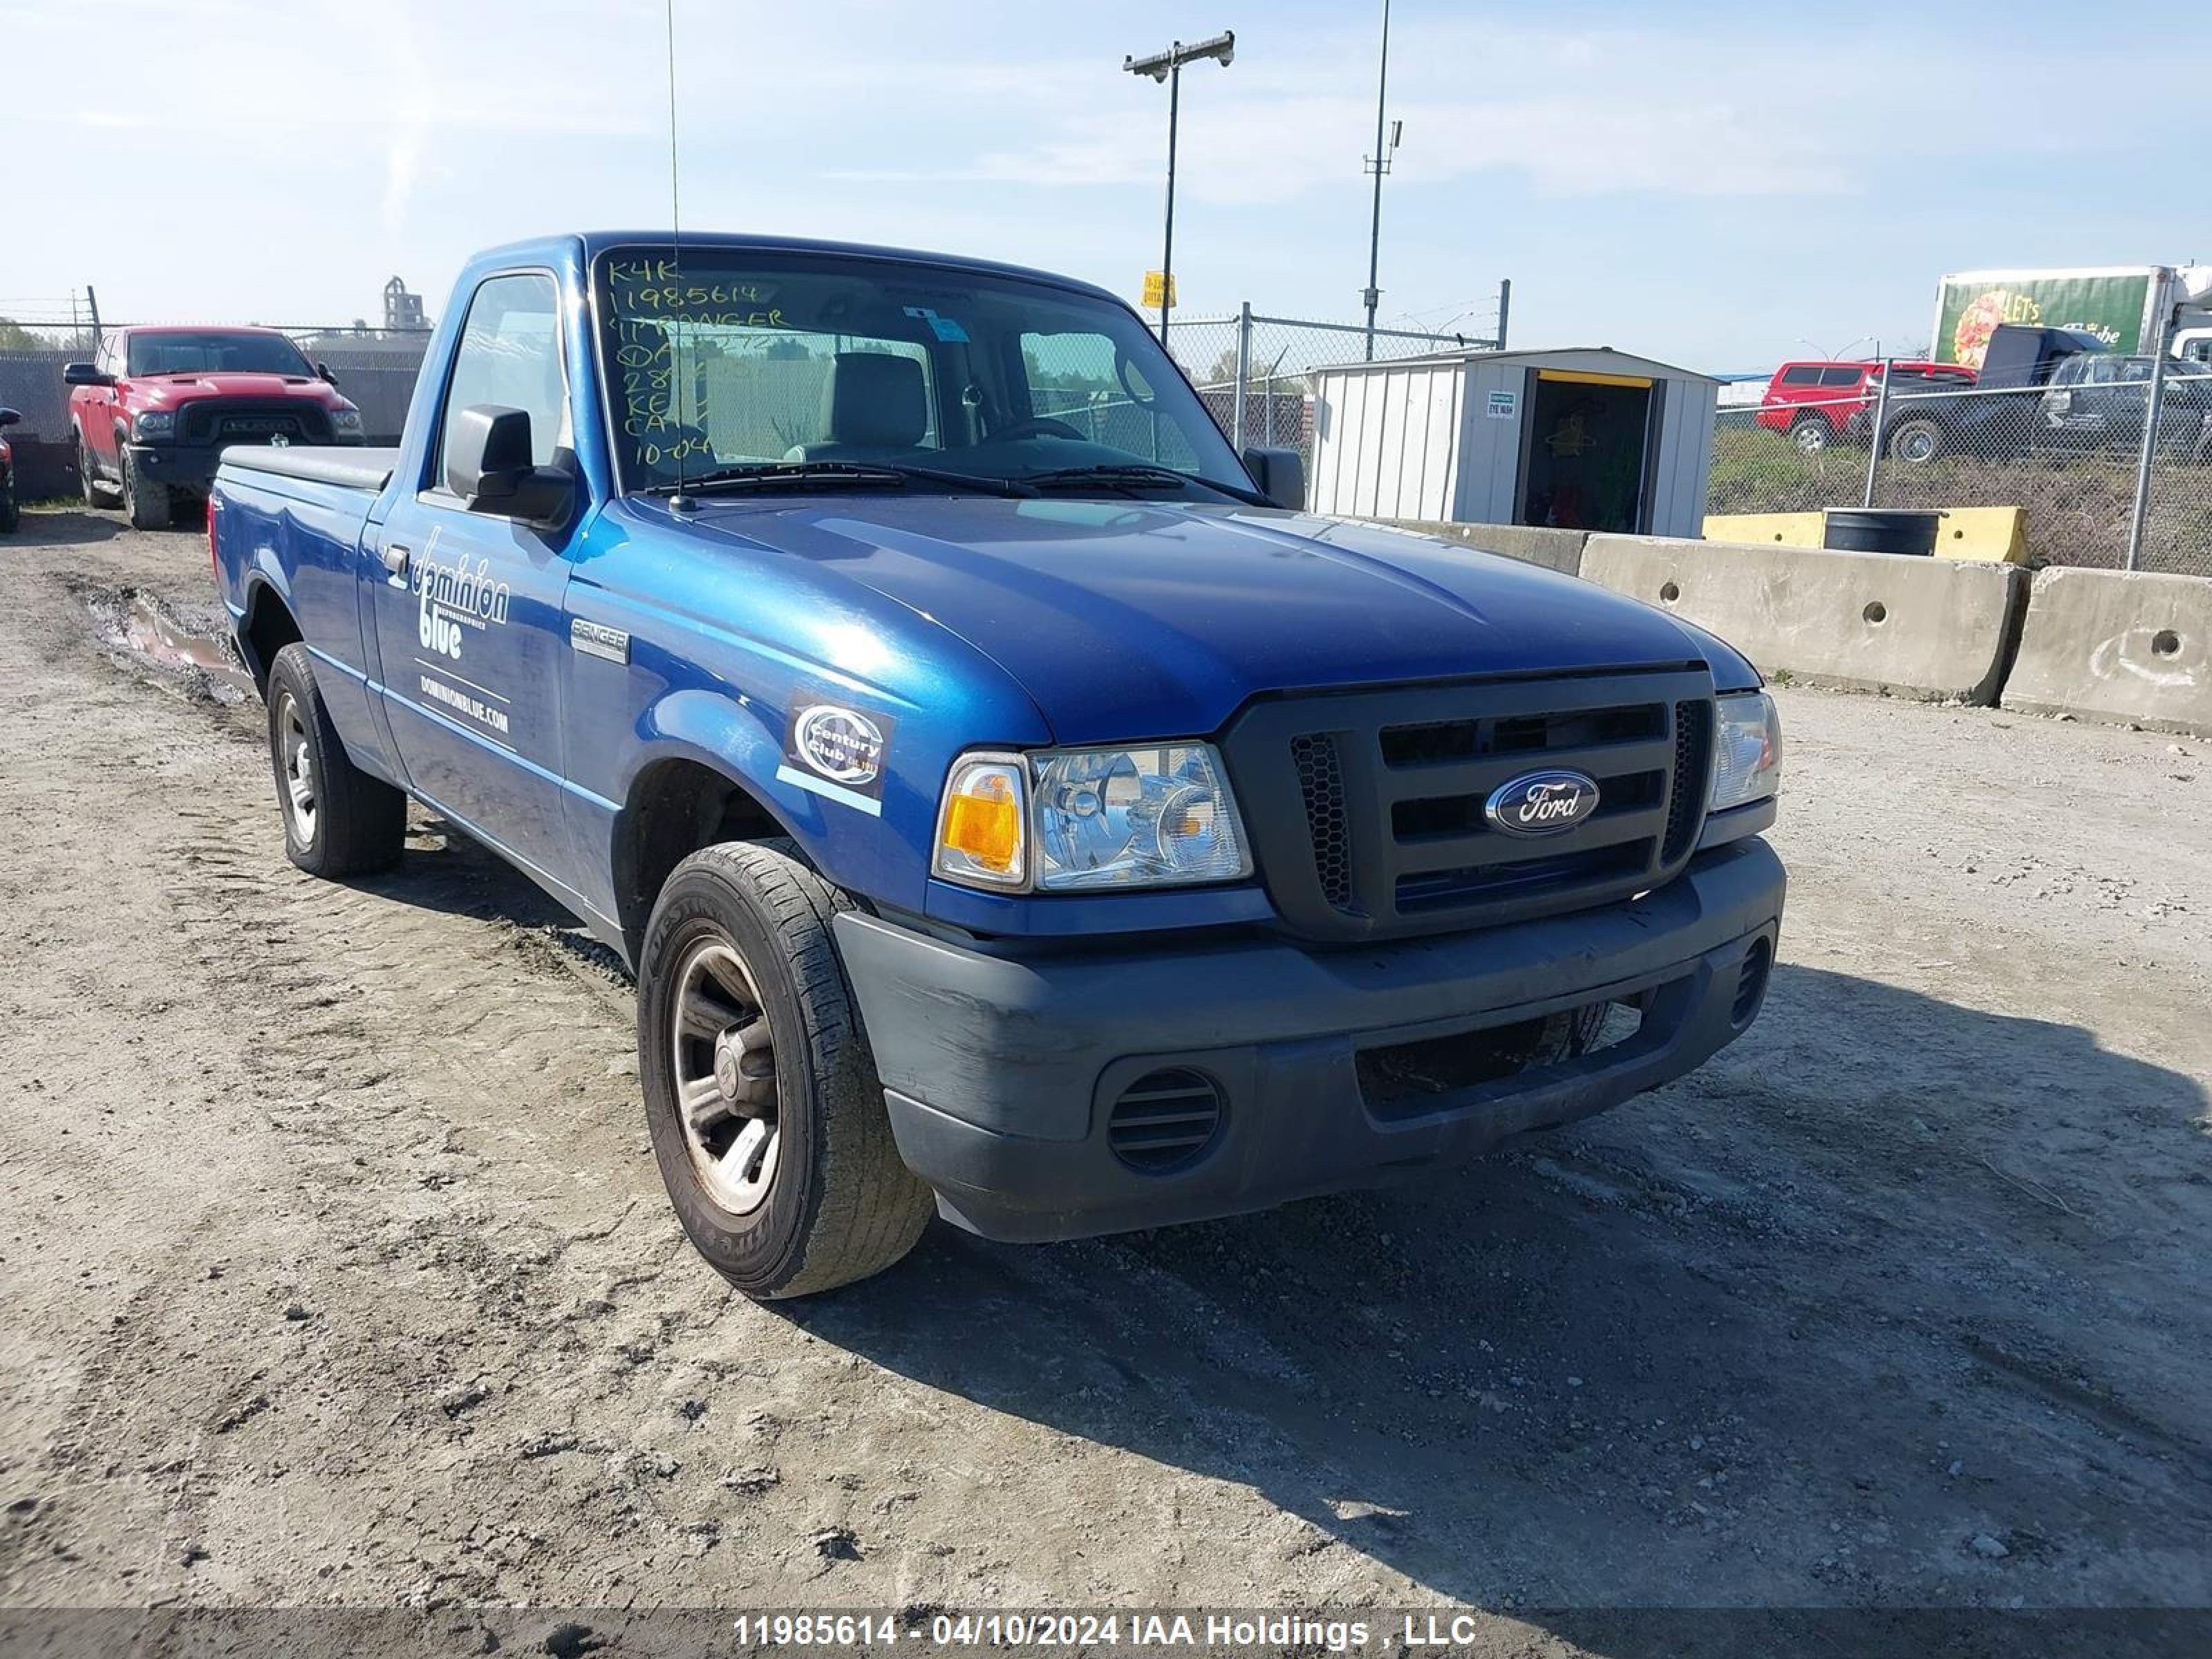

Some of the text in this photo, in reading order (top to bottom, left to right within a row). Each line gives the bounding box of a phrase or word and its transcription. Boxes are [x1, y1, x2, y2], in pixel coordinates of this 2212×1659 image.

[609, 259, 684, 285] K4K
[609, 285, 759, 313] 11985614
[411, 525, 510, 625] dominion
[420, 577, 462, 660] blue
[1519, 782, 1581, 823] Ford
